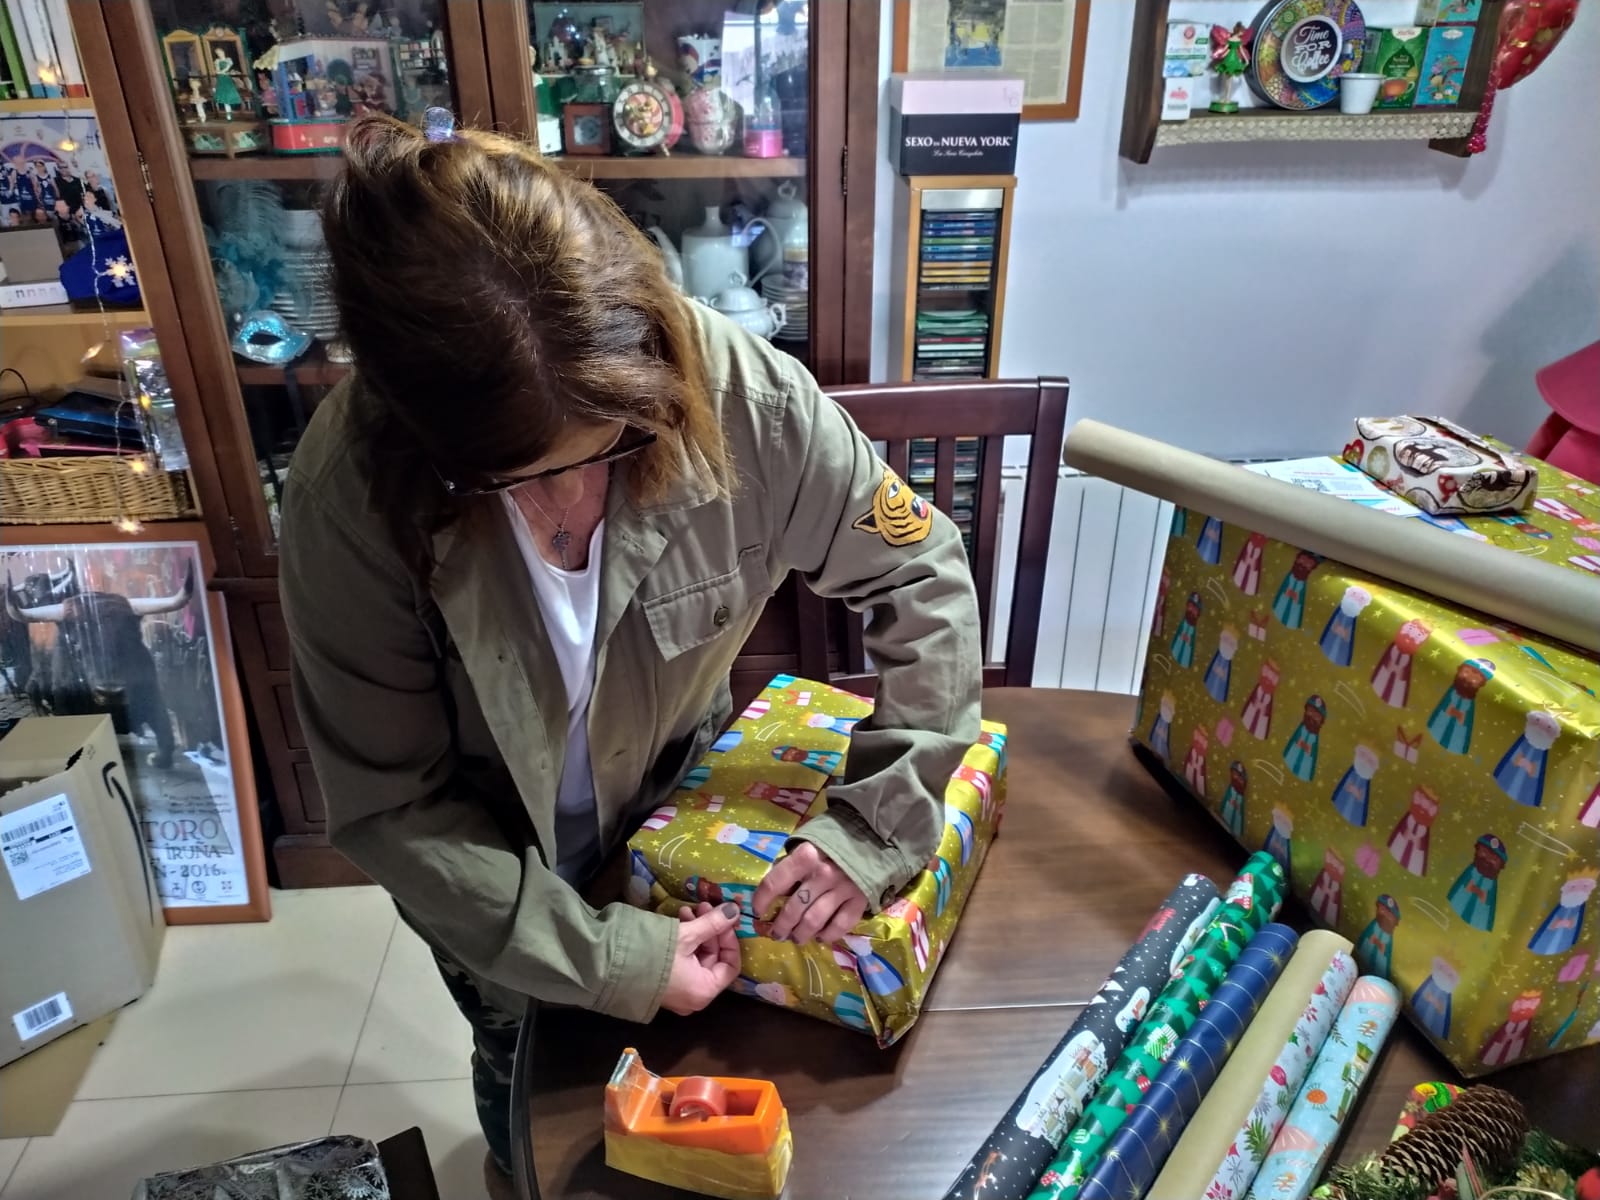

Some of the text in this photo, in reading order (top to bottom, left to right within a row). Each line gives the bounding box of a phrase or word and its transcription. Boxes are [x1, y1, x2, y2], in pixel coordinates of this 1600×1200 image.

[1295, 40, 1332, 54] FOR
[904, 136, 933, 147] SEXO
[941, 135, 978, 148] NUEVA
[979, 135, 1011, 147] YORK
[139, 818, 219, 843] TORO
